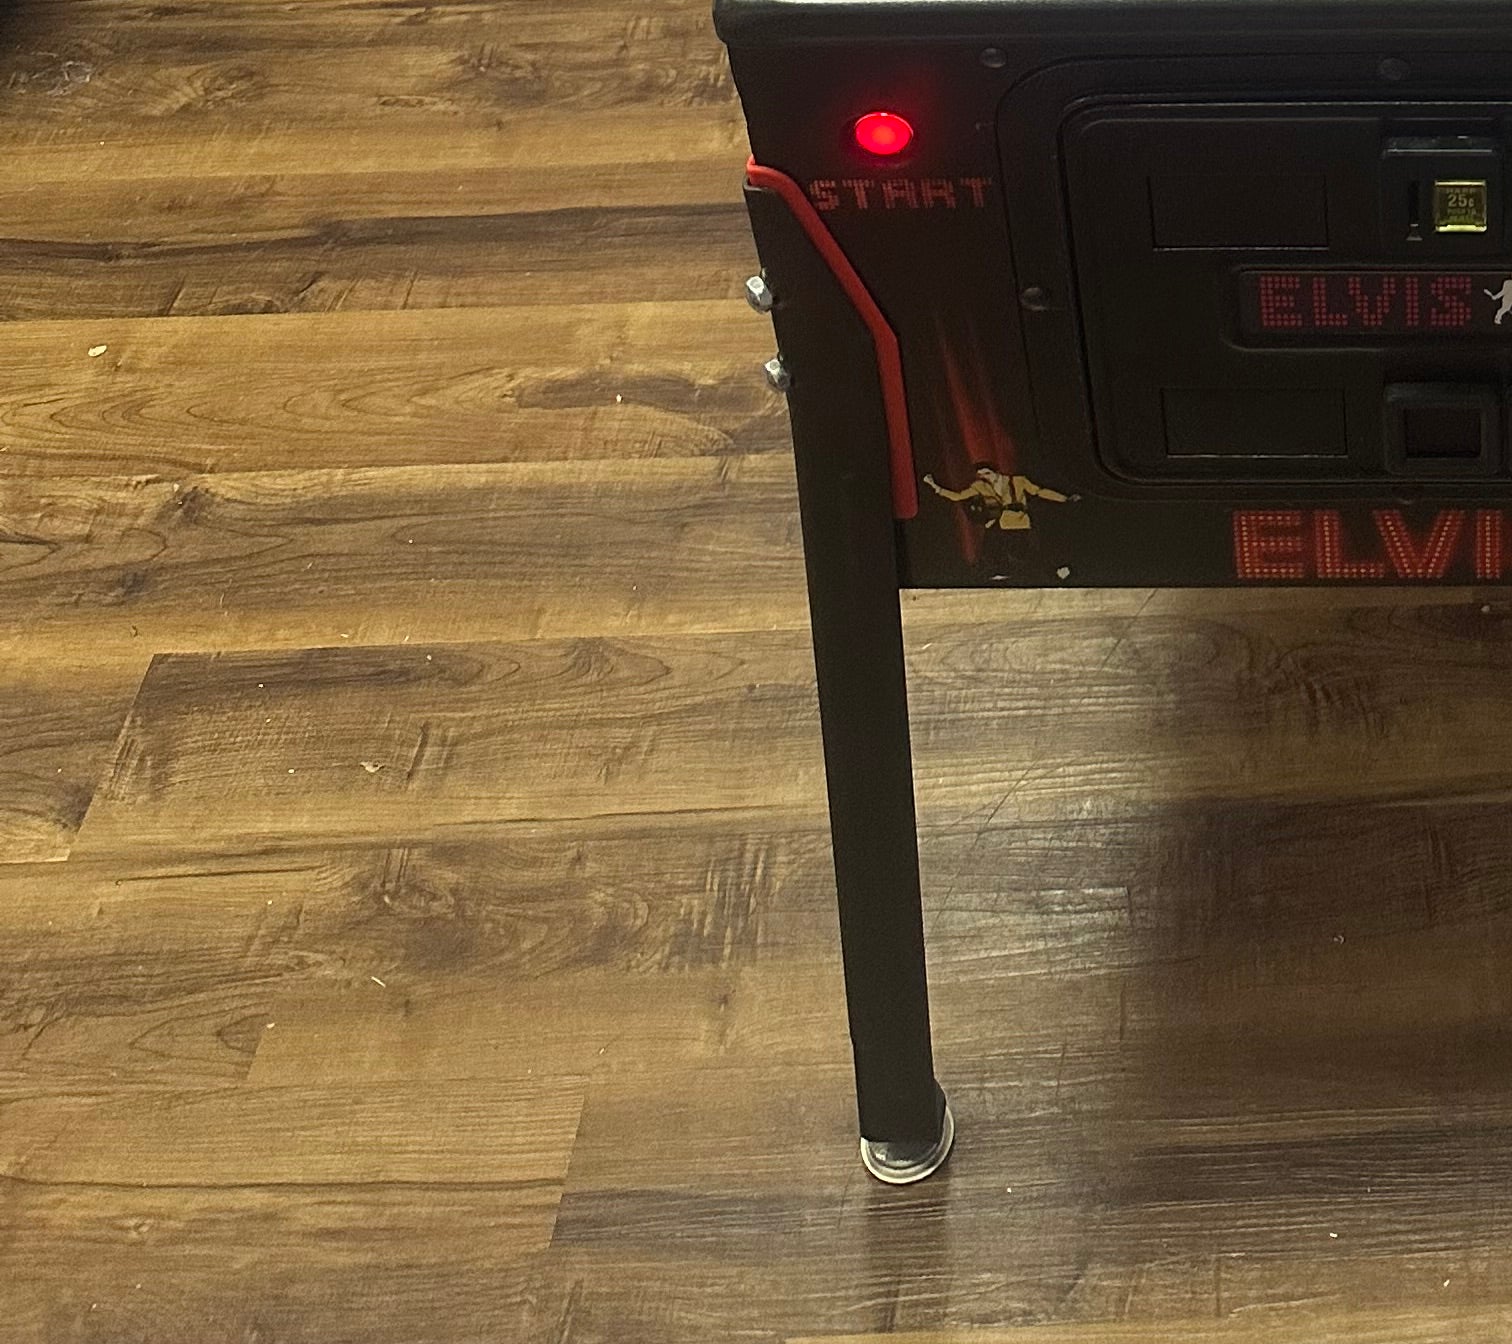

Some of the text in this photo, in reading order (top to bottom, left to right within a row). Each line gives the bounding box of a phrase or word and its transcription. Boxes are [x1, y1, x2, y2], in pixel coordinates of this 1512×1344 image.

[809, 176, 992, 212] START
[1448, 194, 1475, 208] 25¢
[1258, 275, 1472, 328] ELVIS
